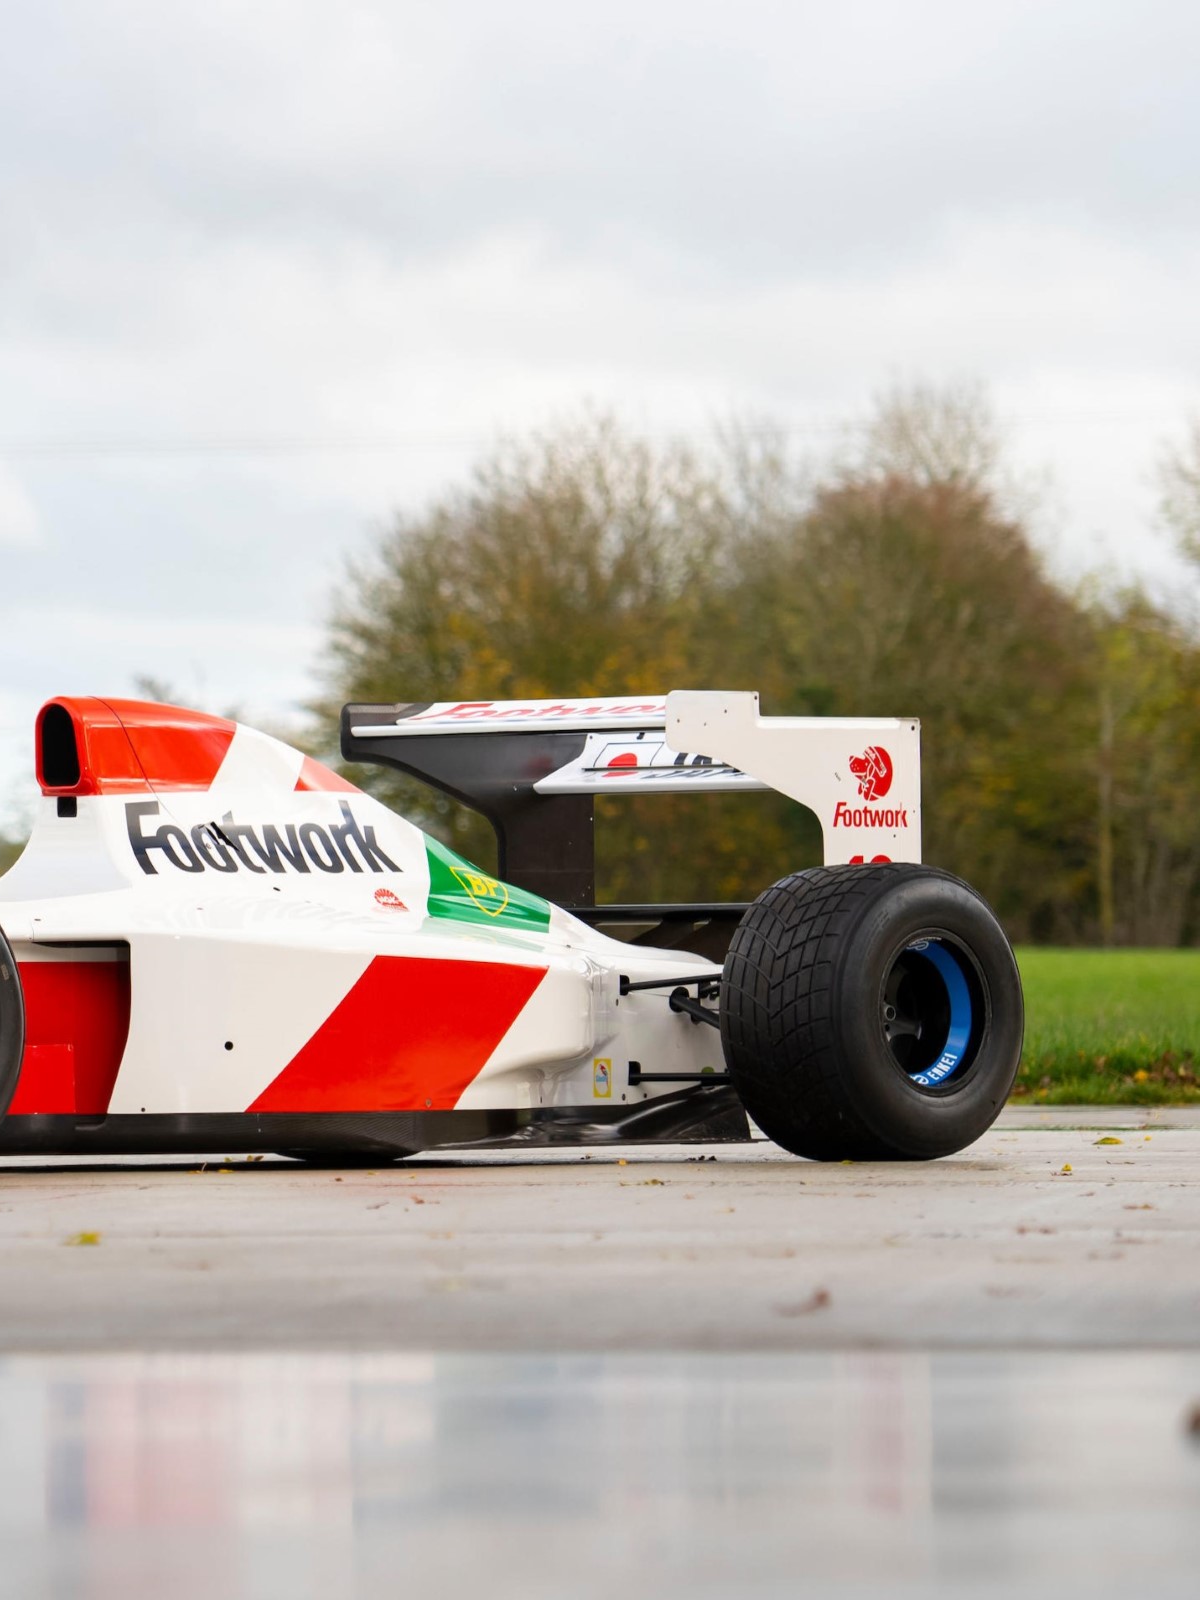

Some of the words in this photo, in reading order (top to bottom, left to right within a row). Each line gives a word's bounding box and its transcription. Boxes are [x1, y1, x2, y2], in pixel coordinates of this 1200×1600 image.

[833, 801, 909, 828] Footwork
[125, 800, 404, 875] Footwork
[463, 873, 498, 897] BP
[926, 1052, 958, 1081] ENKEI
